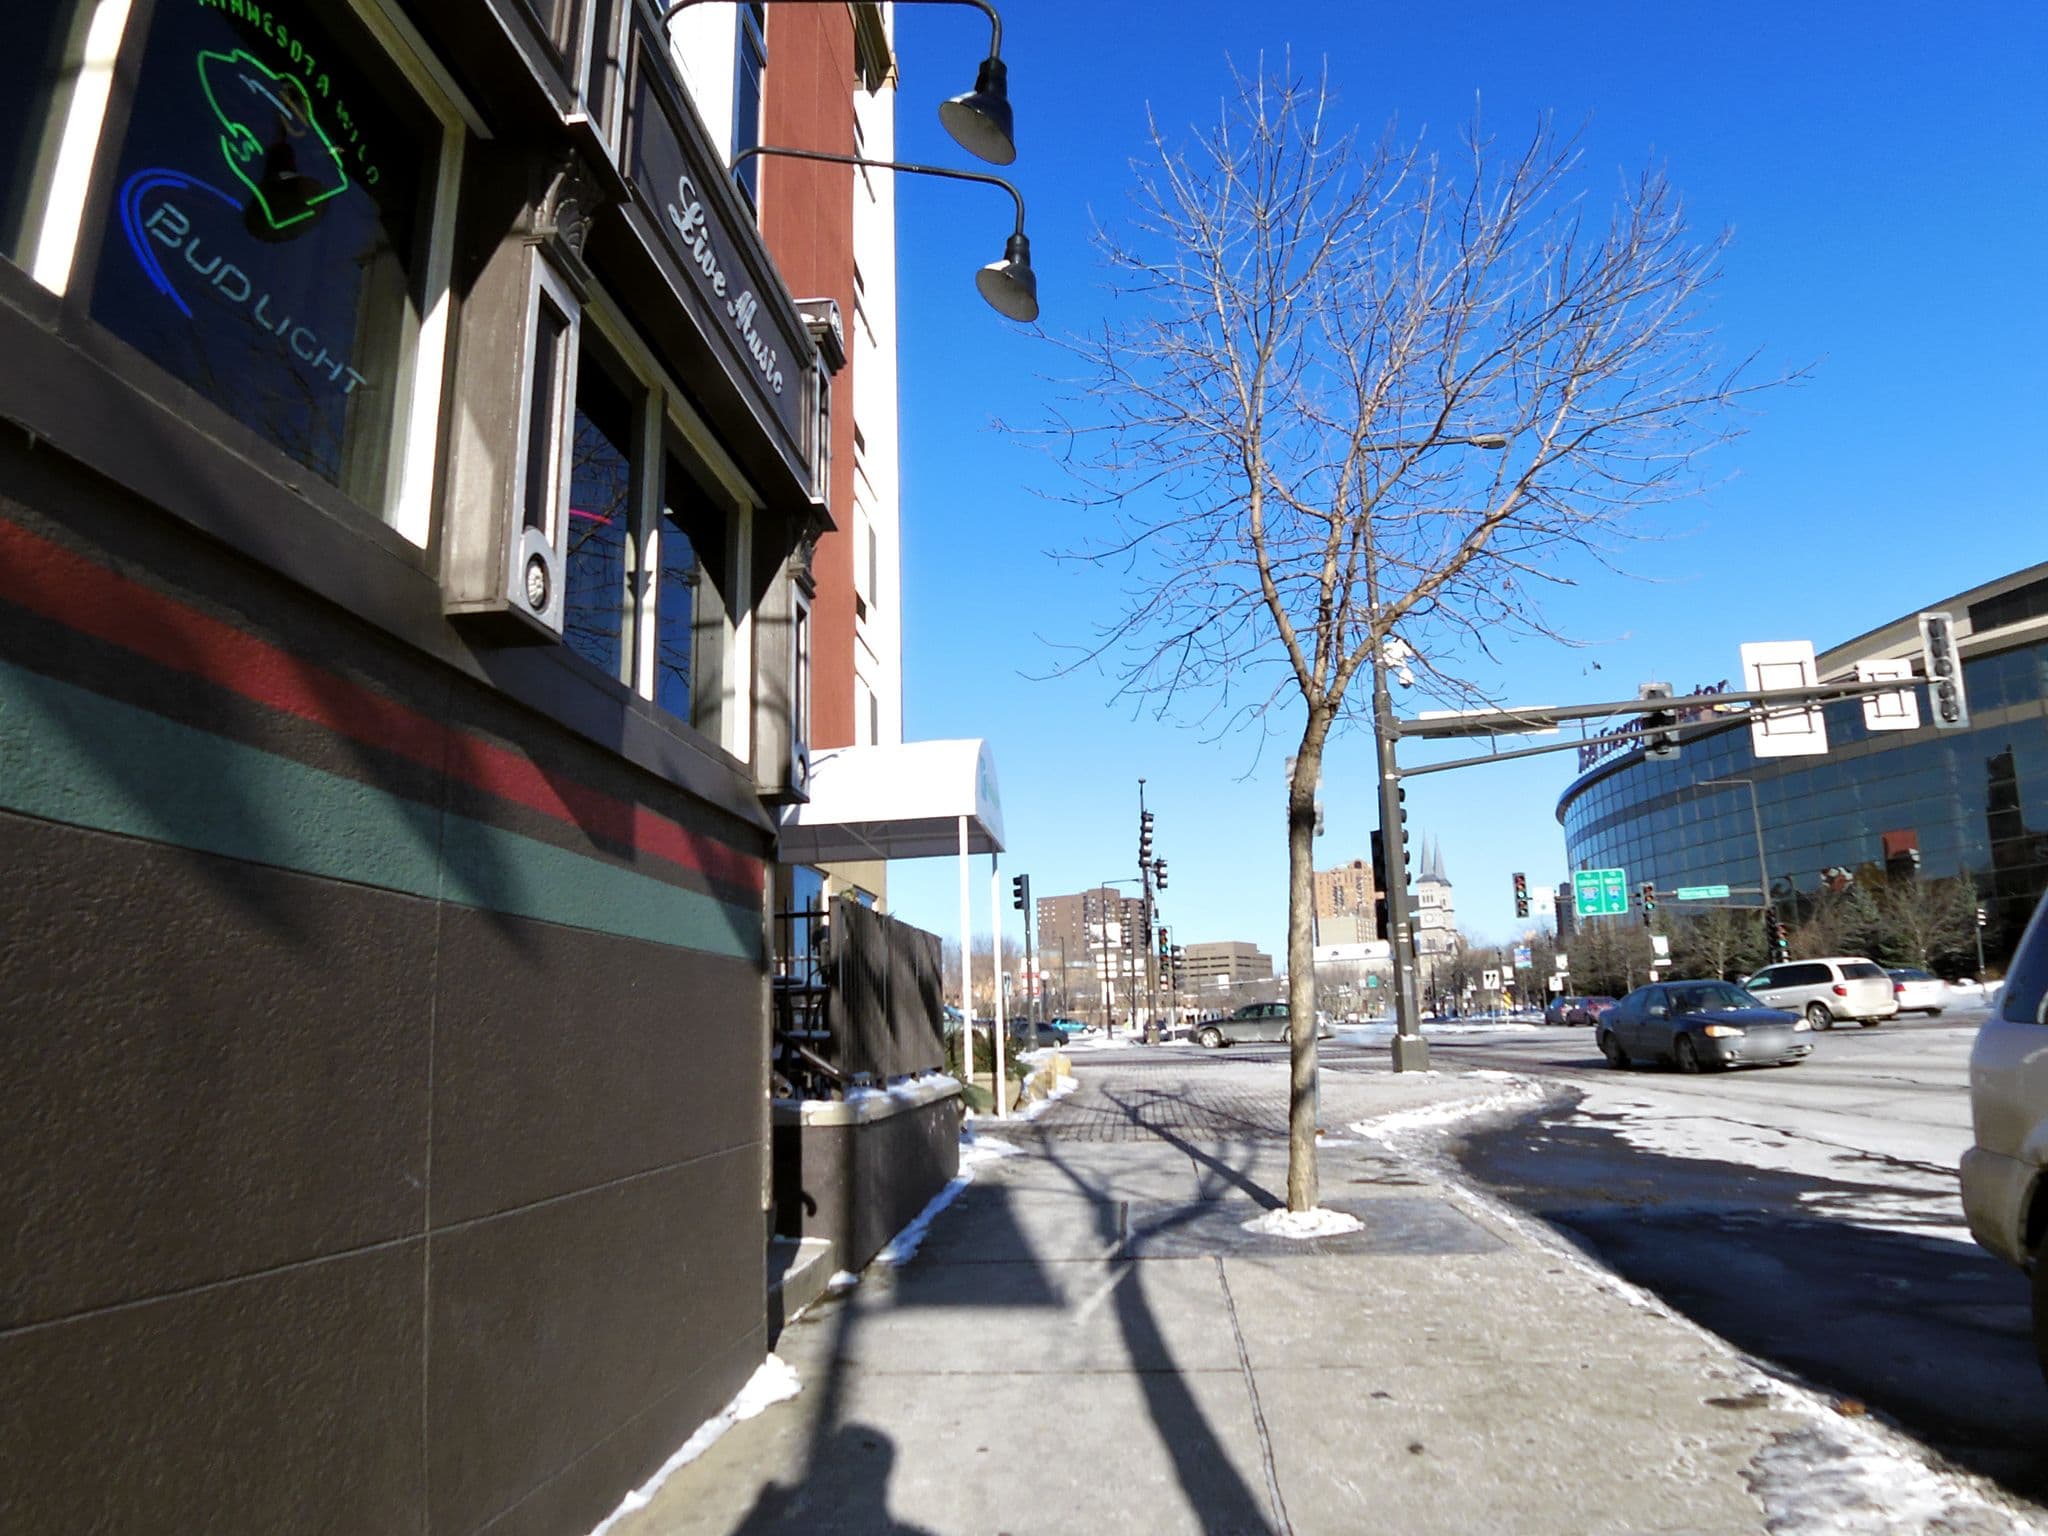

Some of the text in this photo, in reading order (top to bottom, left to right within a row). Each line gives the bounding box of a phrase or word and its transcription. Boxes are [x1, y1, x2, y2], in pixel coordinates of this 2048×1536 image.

[336, 99, 380, 185] WILD
[667, 175, 785, 395] Live Music
[254, 292, 368, 395] LIGHT
